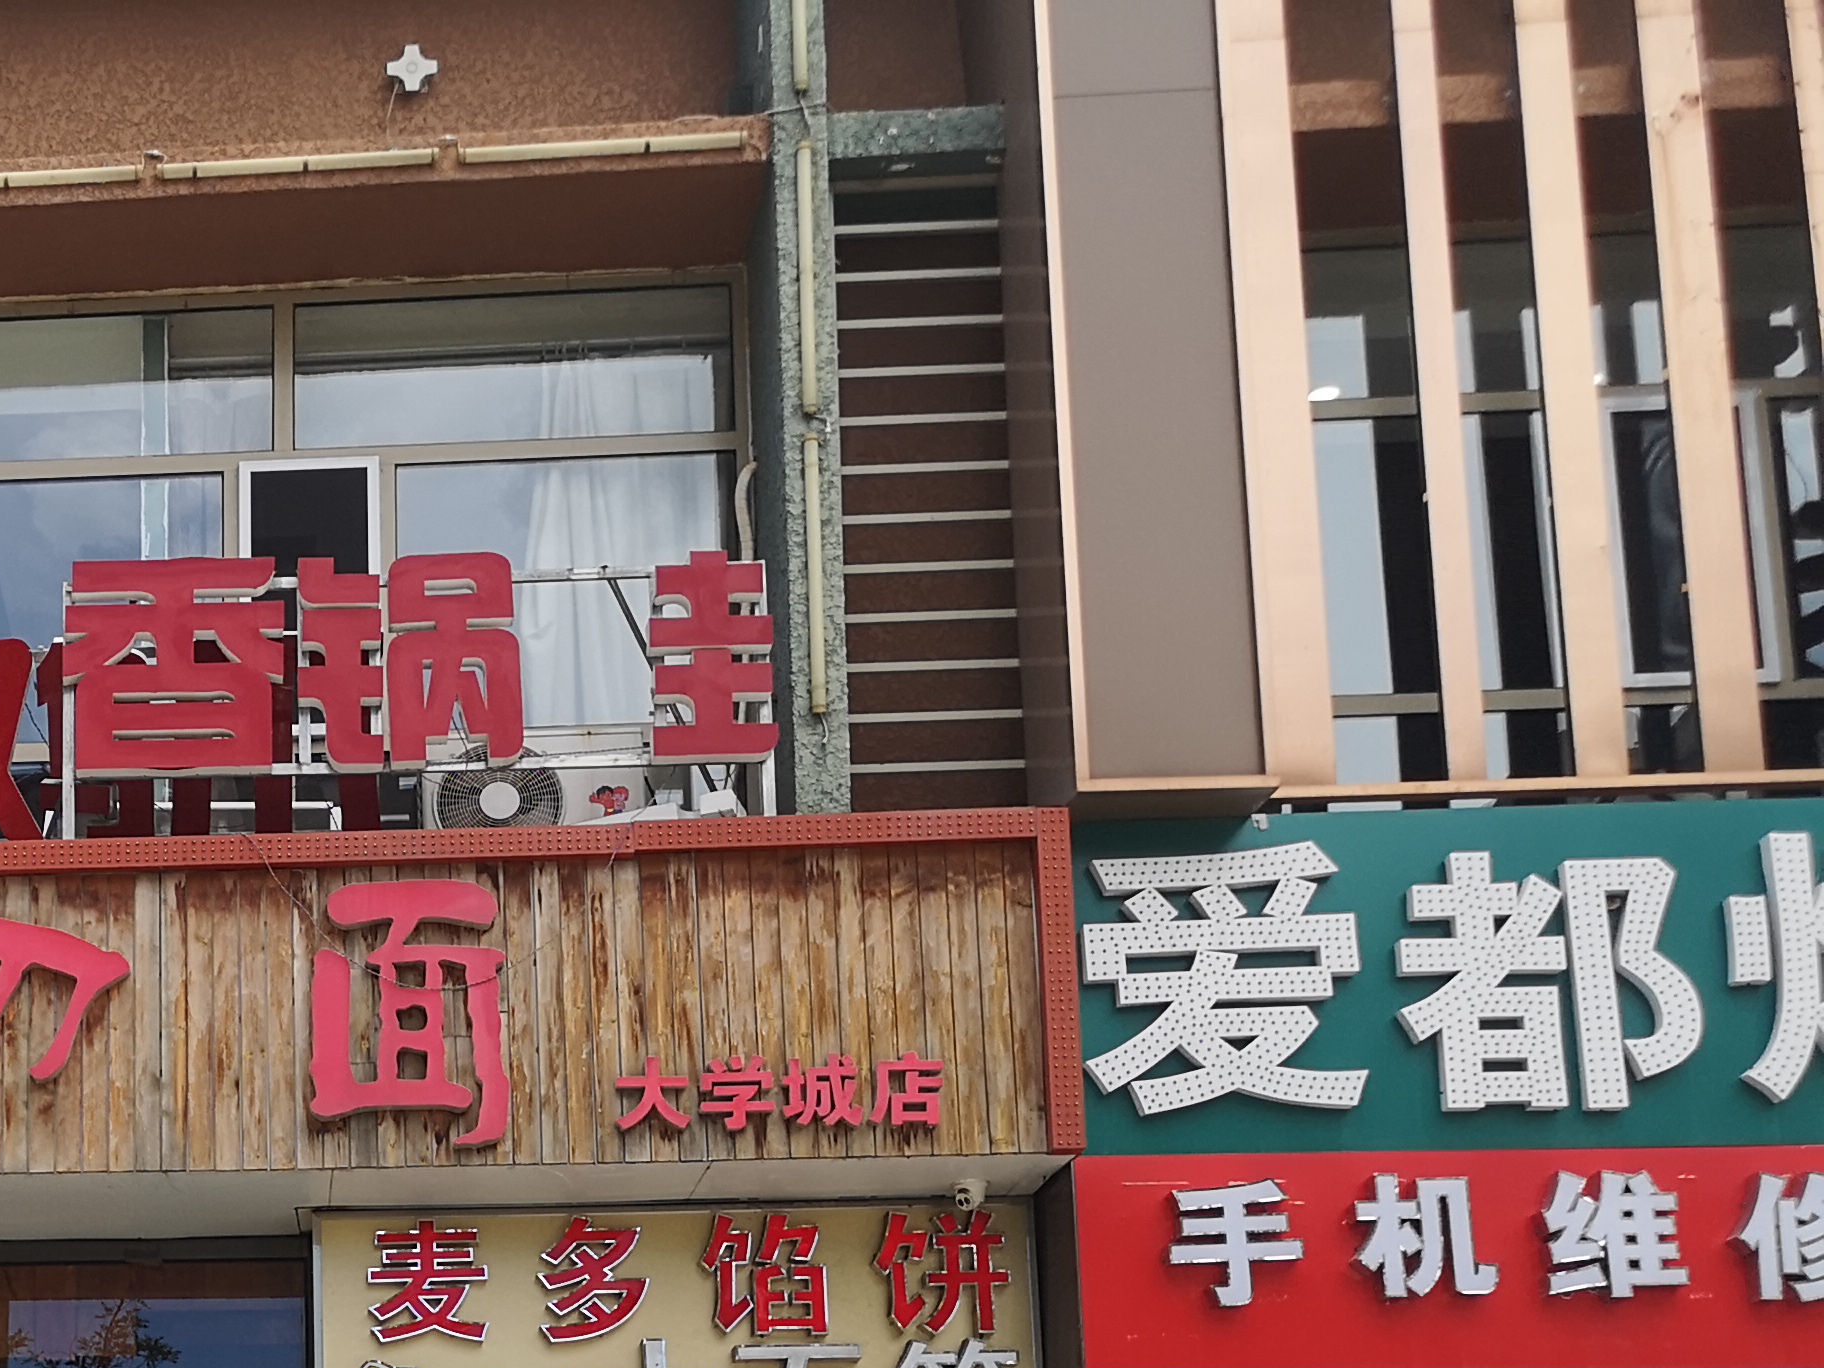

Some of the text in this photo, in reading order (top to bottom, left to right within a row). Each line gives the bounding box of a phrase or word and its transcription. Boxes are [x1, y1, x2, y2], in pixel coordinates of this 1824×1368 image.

[62, 551, 526, 776] 香锅
[614, 1051, 944, 1132] 大学城店
[367, 1208, 1012, 1344] 麦多馅饼
[1166, 1169, 1824, 1308] 手机维修
